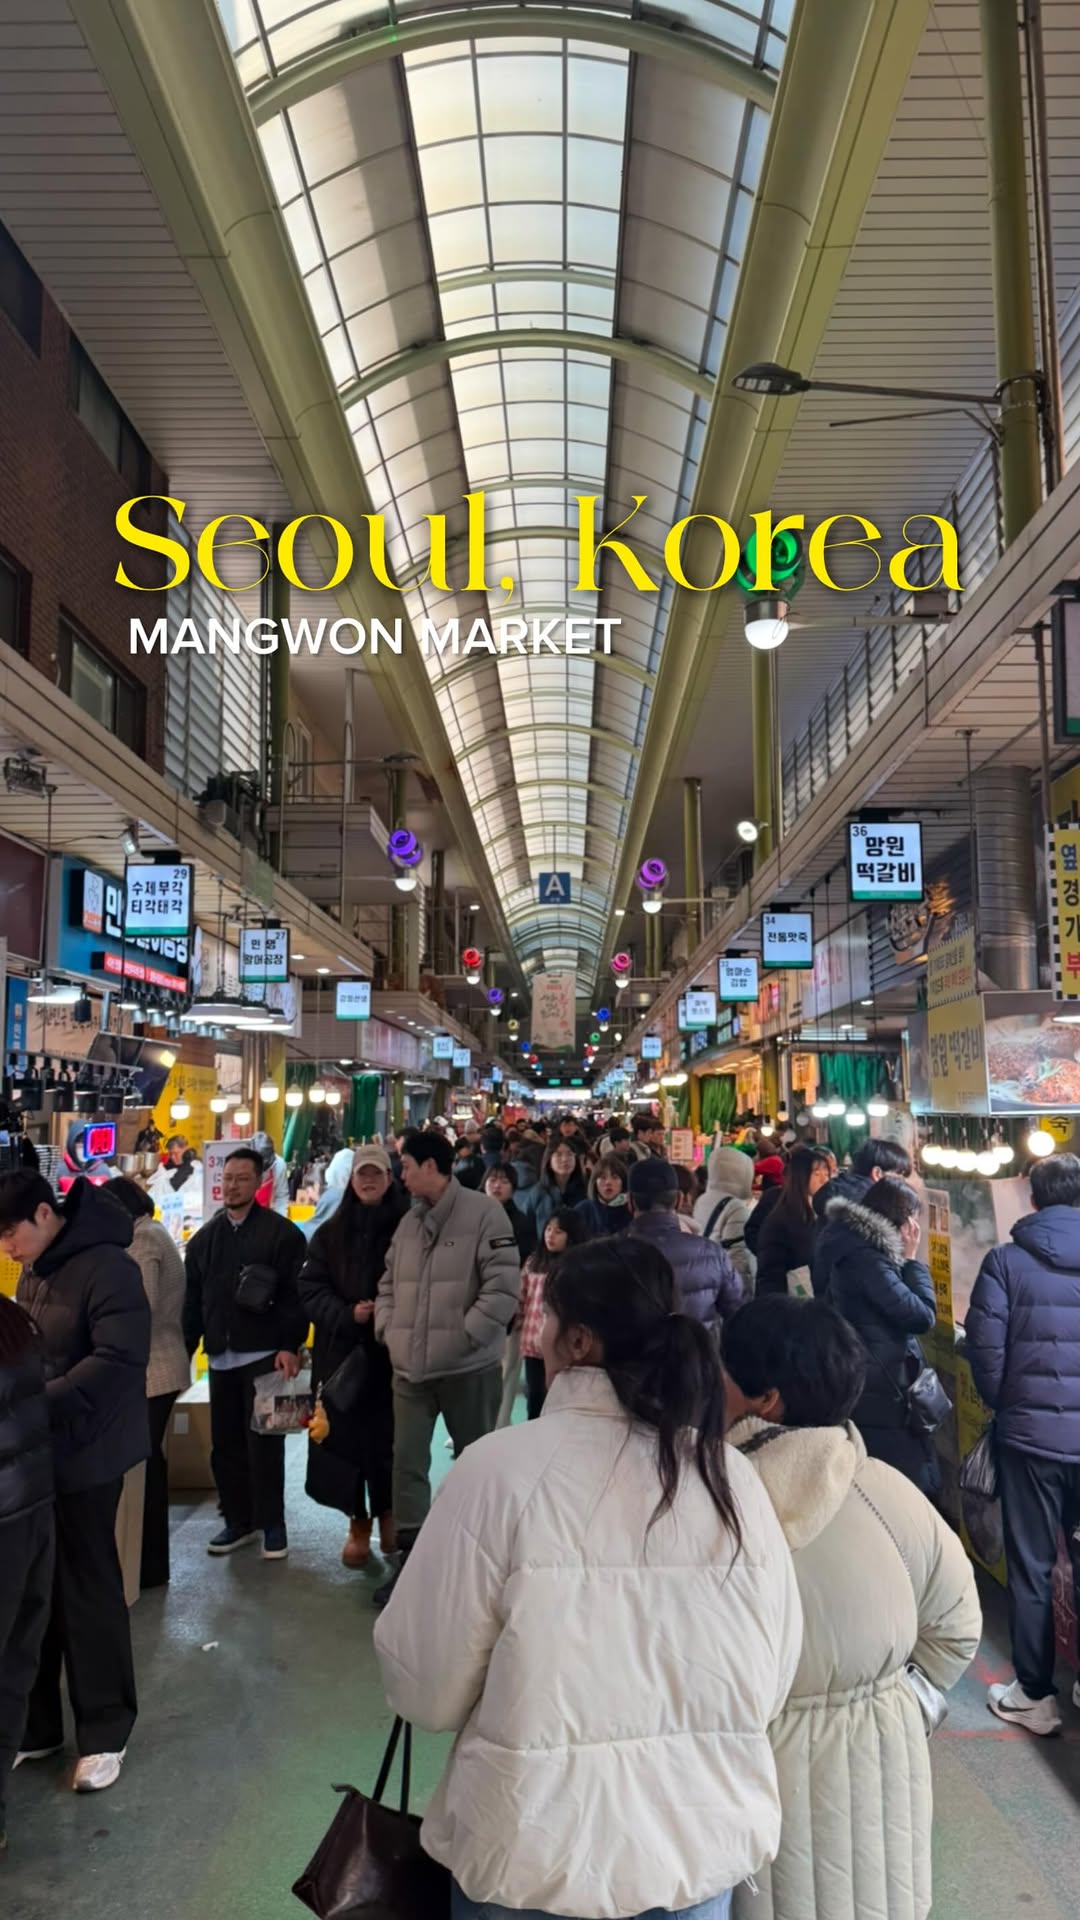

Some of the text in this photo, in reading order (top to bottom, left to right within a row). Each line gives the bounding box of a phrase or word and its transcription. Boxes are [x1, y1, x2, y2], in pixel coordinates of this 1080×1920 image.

[852, 825, 868, 837] 36
[865, 836, 905, 857] 망원
[173, 868, 188, 880] 29
[856, 862, 915, 883] 떡갈비
[131, 881, 184, 896] 수제부각
[544, 874, 565, 896] A
[131, 899, 183, 915] 티각태각
[765, 916, 776, 925] 34
[275, 931, 286, 940] 27
